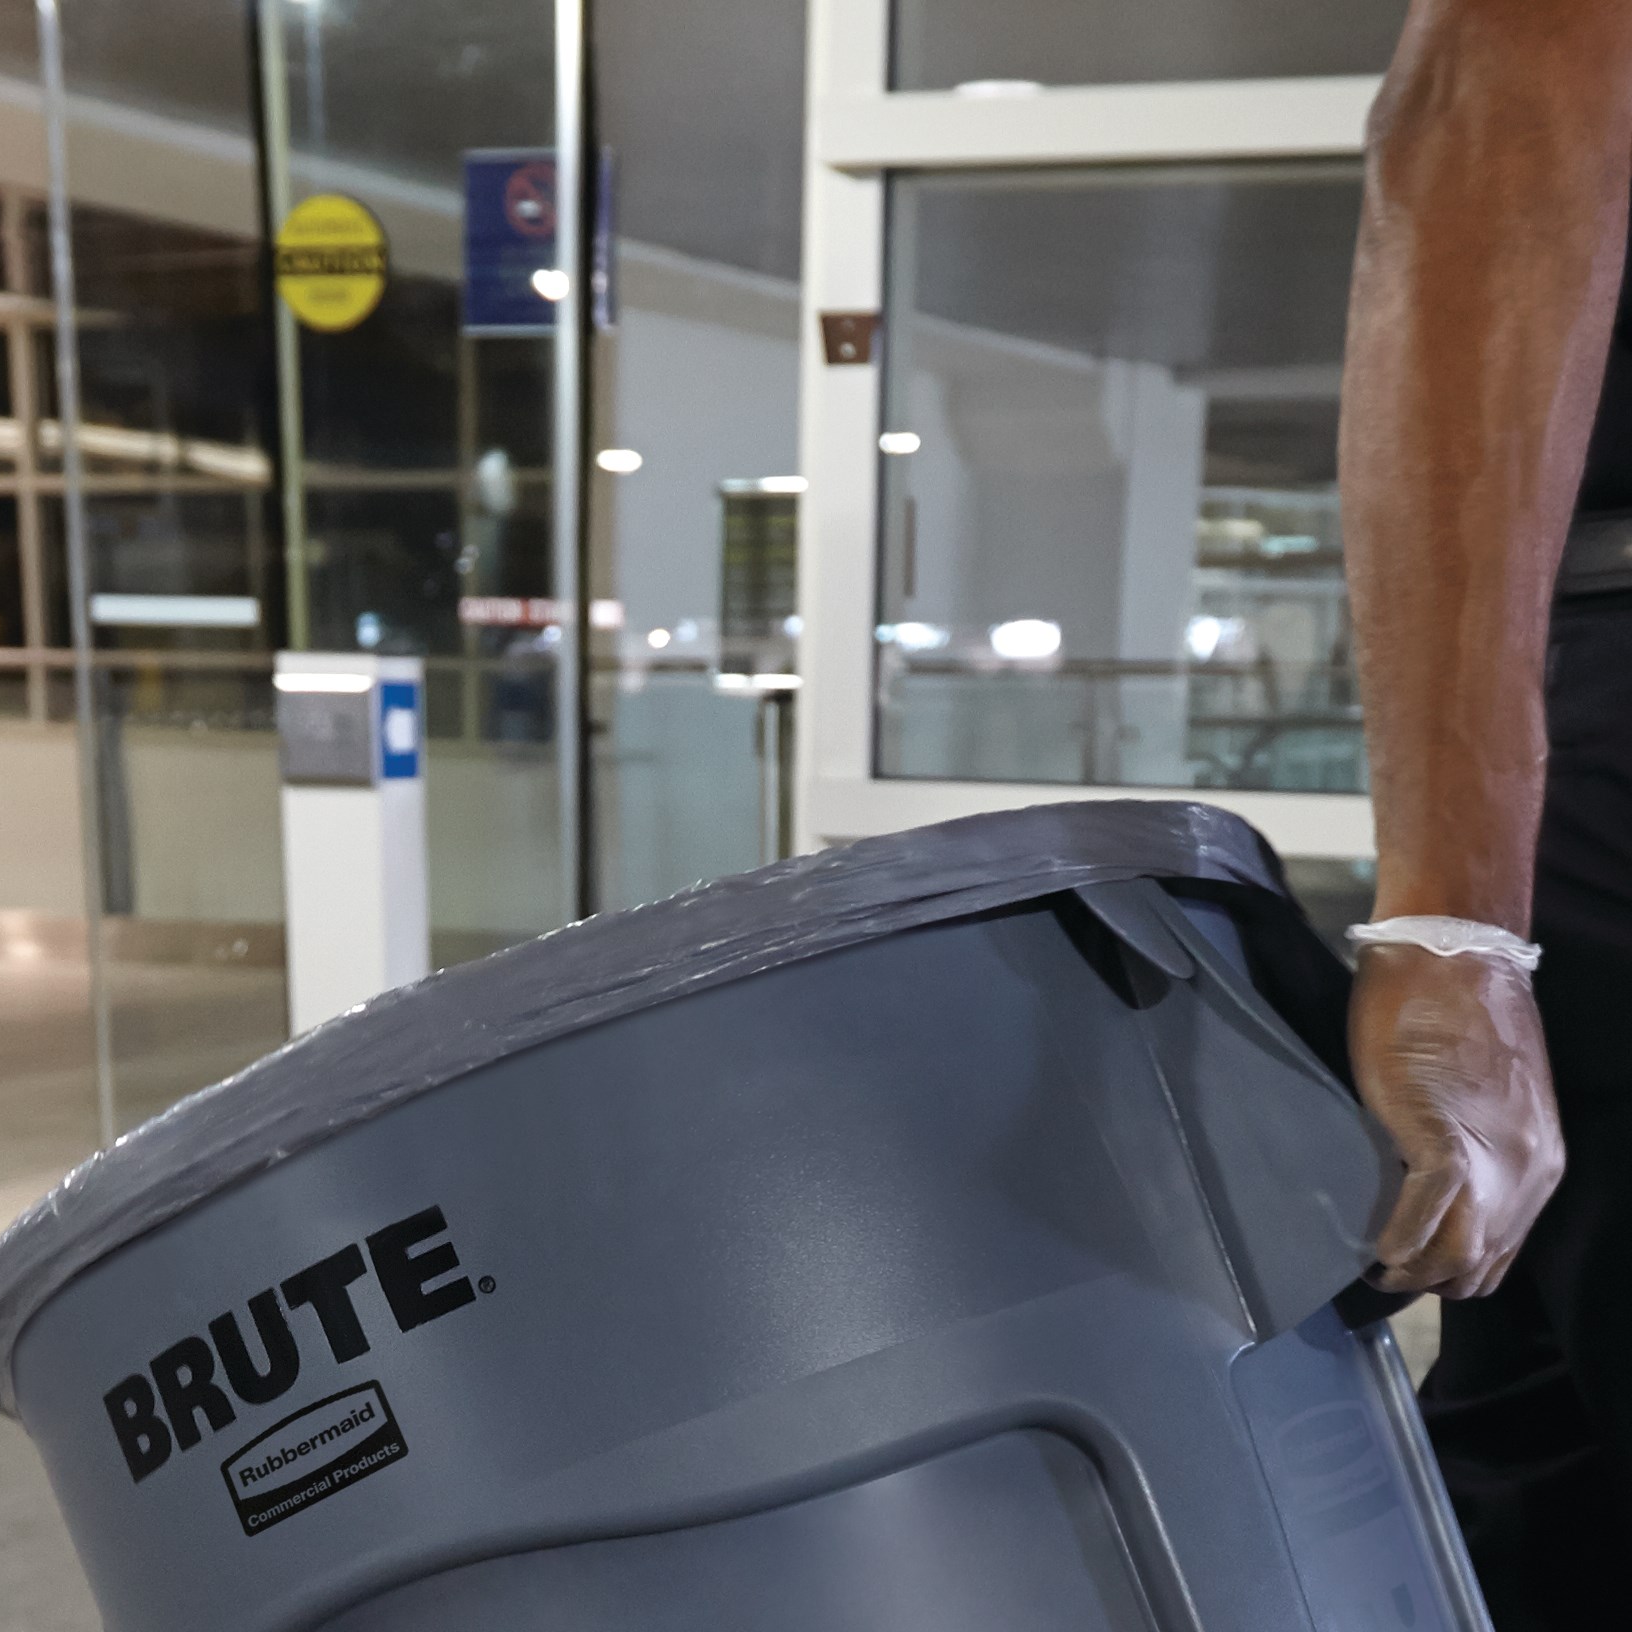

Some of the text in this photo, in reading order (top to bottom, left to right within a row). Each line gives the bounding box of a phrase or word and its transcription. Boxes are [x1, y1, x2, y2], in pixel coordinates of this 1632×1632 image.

[238, 1402, 376, 1487] Rubbermaid
[248, 1442, 401, 1528] Commercial Products
